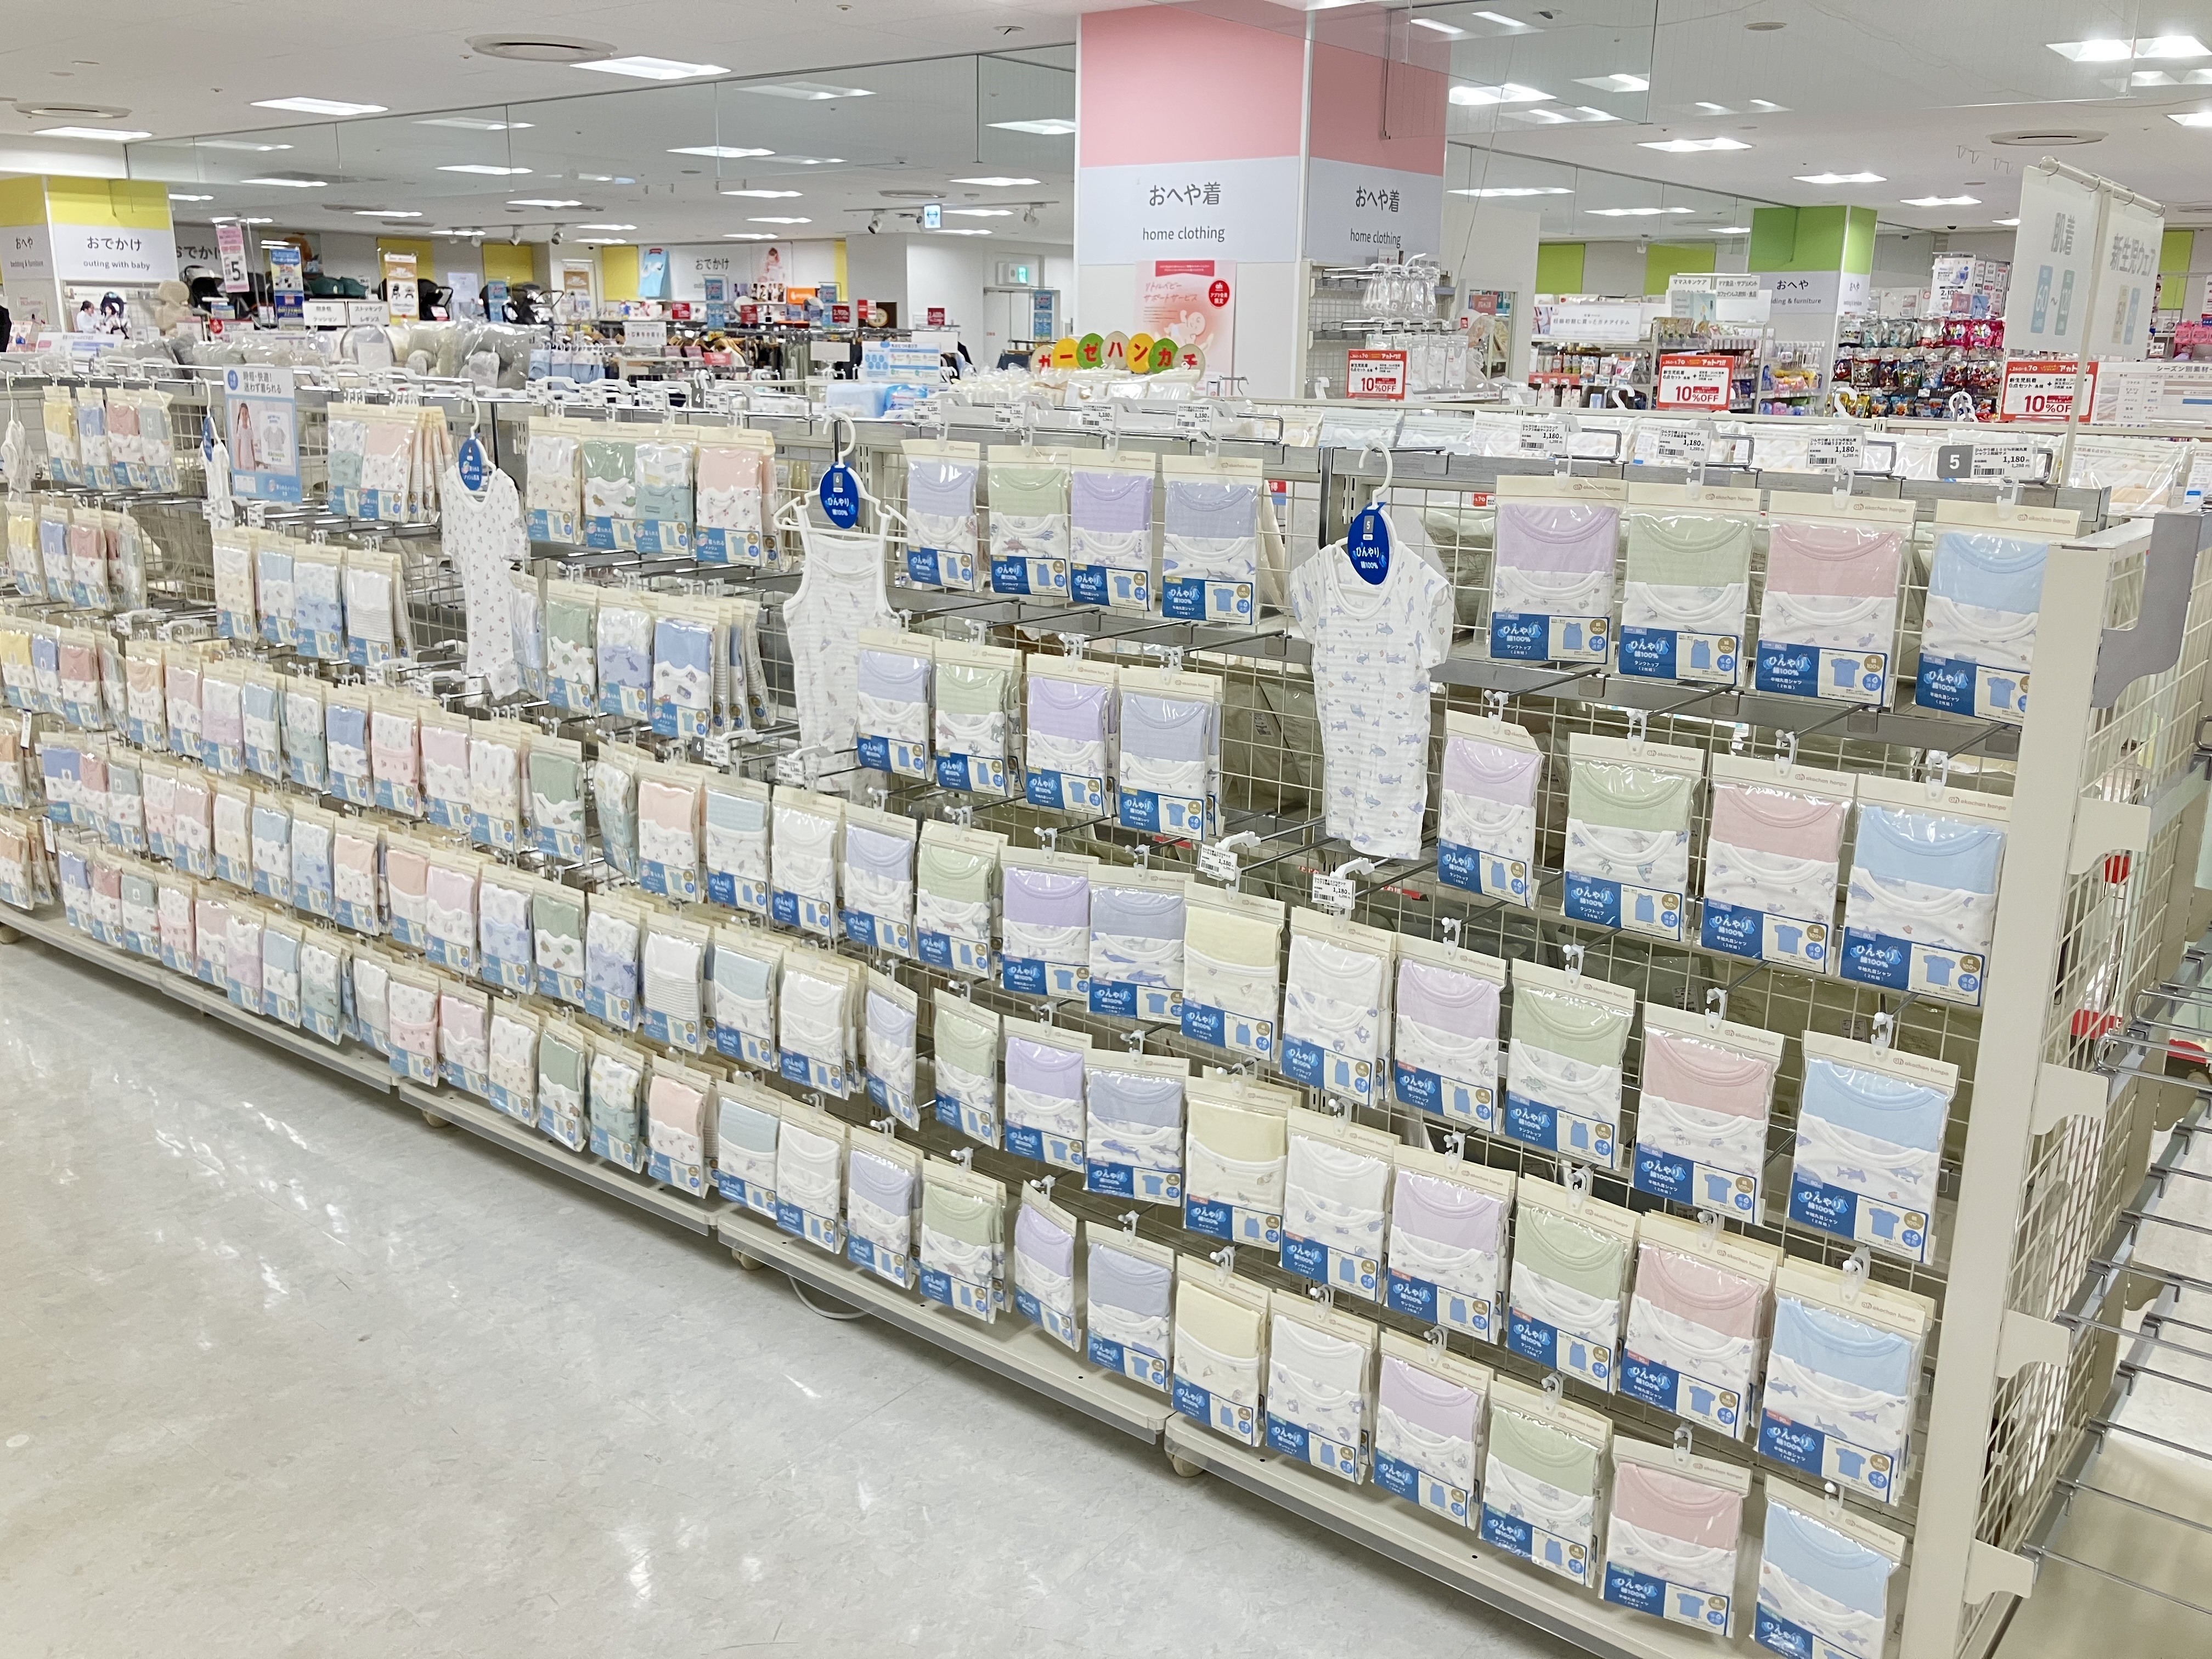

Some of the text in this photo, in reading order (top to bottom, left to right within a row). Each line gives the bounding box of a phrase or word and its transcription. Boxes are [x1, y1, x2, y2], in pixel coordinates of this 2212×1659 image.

[1149, 182, 1221, 206] おへや着
[1356, 186, 1400, 212] おへや着
[1143, 226, 1225, 242] home clothing
[1350, 228, 1401, 249] home clothing
[87, 236, 142, 251] おでかけ
[83, 260, 110, 269] outing
[131, 261, 150, 270] baby
[230, 261, 240, 280] 5
[695, 257, 729, 270] おでかけ
[1777, 279, 1809, 290] おへや
[695, 394, 701, 403] 4
[1949, 454, 1960, 470] 5
[827, 497, 850, 507] ひんやり
[1366, 521, 1370, 529] 5
[1356, 546, 1379, 558] ひんやり
[998, 565, 1020, 575] ひんやり
[1077, 574, 1100, 586] ひんやり
[1170, 589, 1196, 600] ひんやり
[1503, 625, 1535, 638] ひんやり
[1630, 640, 1663, 652] ひんやり
[1634, 651, 1658, 659] 綿100%
[1769, 656, 1804, 669] ひんやり
[1772, 667, 1799, 676] 綿100%
[1928, 670, 1962, 685] ひんやり
[1932, 681, 1957, 692] 綿100%
[696, 742, 702, 752] 6
[942, 760, 963, 772] ひんやり
[1032, 777, 1054, 791] ひんやり
[1125, 798, 1151, 811] ひんやり
[1446, 854, 1470, 868] ひんやり
[1449, 863, 1468, 873] 綿100%
[1576, 887, 1608, 901] ひんやり
[1580, 897, 1604, 907] 綿100%
[1580, 907, 1605, 916] タンクトップ
[1715, 916, 1749, 931] ひんやり
[1718, 926, 1745, 938] 綿100%
[1857, 945, 1893, 961] ひんやり
[1860, 956, 1889, 968] 綿100%
[1010, 966, 1039, 978] ひんやり
[1098, 989, 1127, 1002] ひんやり
[1190, 1012, 1215, 1026] ひんやり
[1289, 1048, 1314, 1064] ひんやり
[1403, 1075, 1431, 1091] ひんやり
[1515, 1108, 1544, 1125] ひんやり
[1646, 1160, 1679, 1178] ひんやり
[1804, 1190, 1841, 1210] ひんやり
[1195, 1207, 1223, 1222] ひんやり
[1807, 1201, 1835, 1216] 綿100%
[1291, 1245, 1318, 1260] ひんやり
[1397, 1283, 1426, 1301] ひんやり
[1517, 1323, 1548, 1342] ひんやり
[1633, 1367, 1666, 1387] ひんやり
[1178, 1387, 1203, 1406] ひんやり
[1274, 1426, 1301, 1446] ひんやり
[1771, 1426, 1808, 1448] ひんやり
[1382, 1463, 1408, 1483] ひんやり
[1491, 1519, 1523, 1539] ひんやり
[1616, 1577, 1656, 1597] ひんやり
